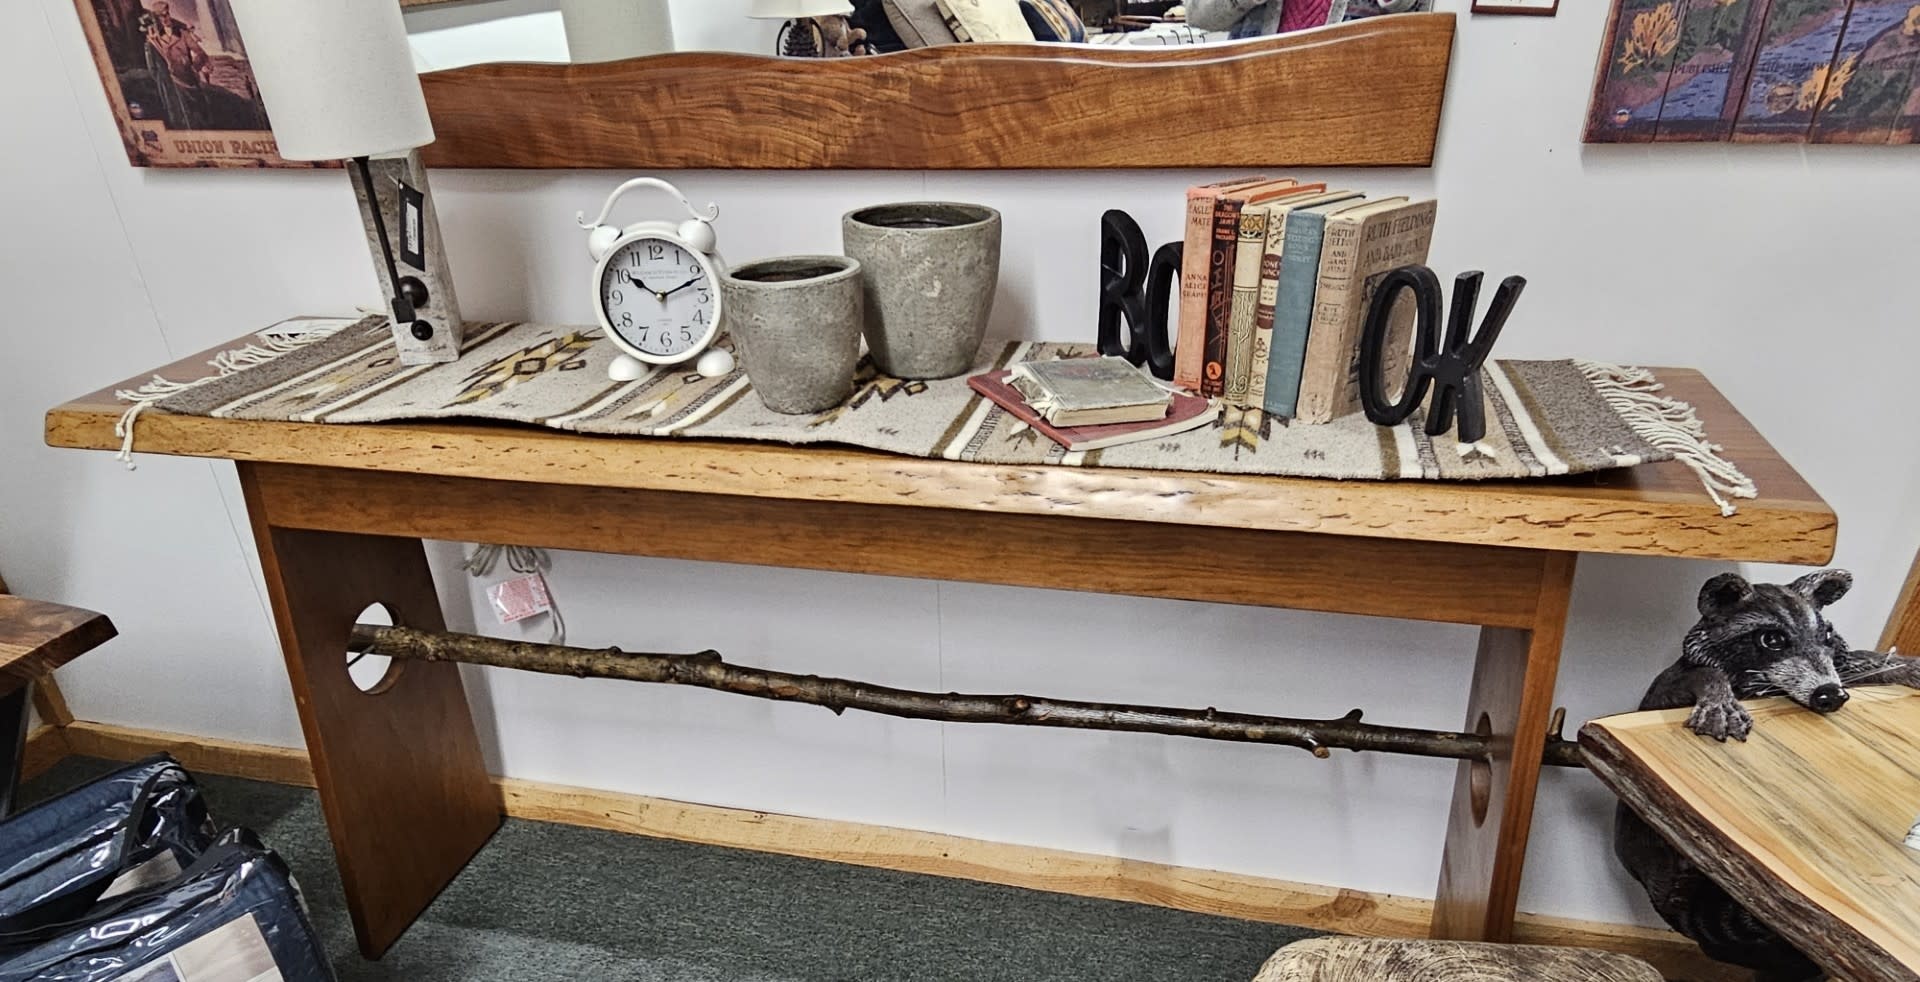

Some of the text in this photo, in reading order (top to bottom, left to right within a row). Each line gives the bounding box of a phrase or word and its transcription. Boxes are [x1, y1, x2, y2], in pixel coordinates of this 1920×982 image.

[174, 139, 226, 155] UNION
[1190, 216, 1211, 226] MATE
[1366, 209, 1434, 242] RUTH FIELDING
[630, 251, 641, 267] 11
[648, 244, 664, 260] 12
[675, 249, 681, 265] 1
[1332, 250, 1347, 258] AND
[616, 269, 632, 284] 10
[1185, 273, 1208, 281] ANNA
[611, 289, 623, 306] 9
[697, 287, 709, 304] 3
[622, 311, 634, 328] 8
[692, 308, 704, 325] 4
[639, 325, 650, 342] 7
[660, 331, 673, 347] 6
[680, 325, 692, 342] 5
[1360, 264, 1527, 443] OK
